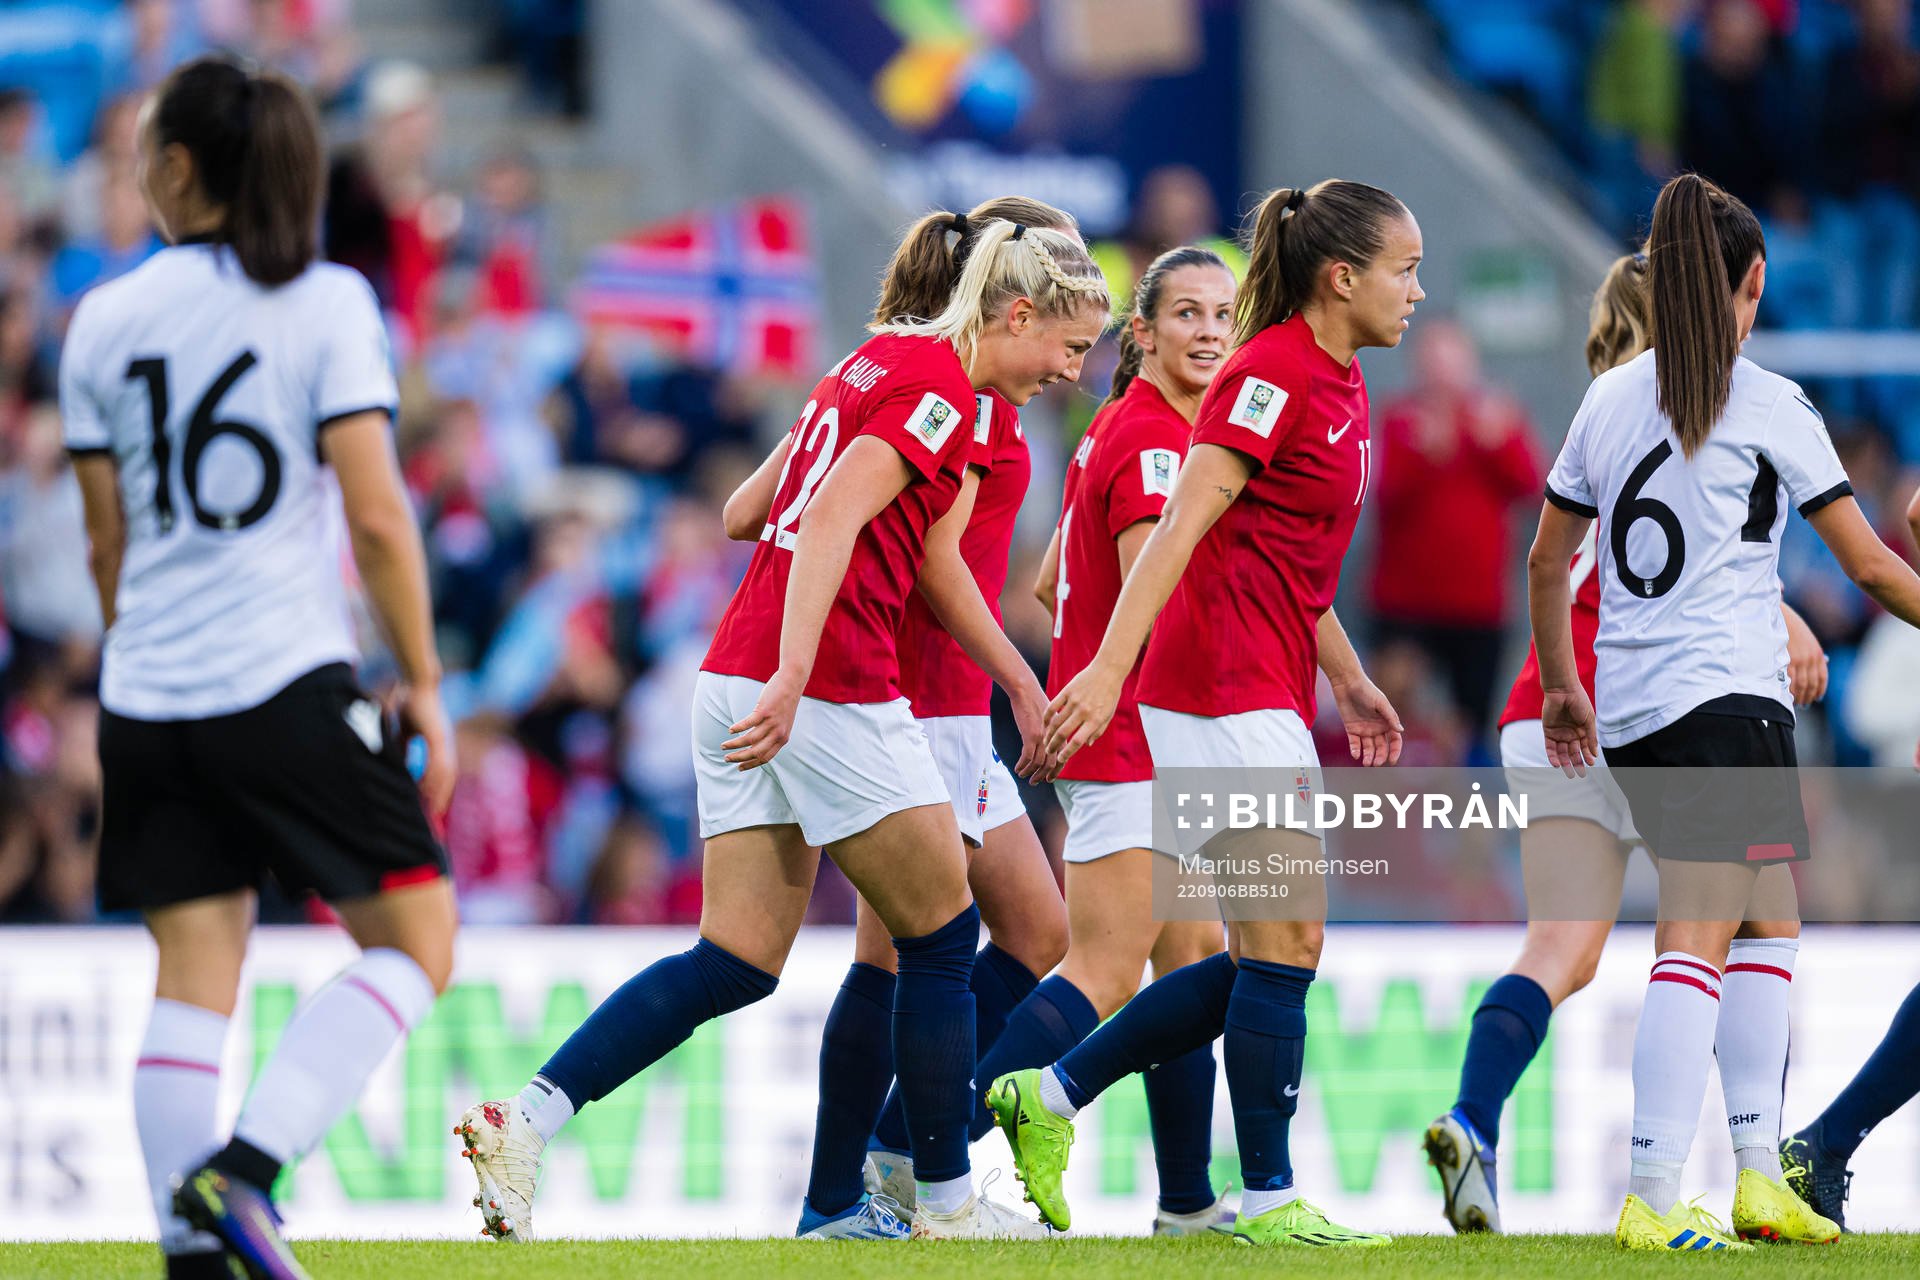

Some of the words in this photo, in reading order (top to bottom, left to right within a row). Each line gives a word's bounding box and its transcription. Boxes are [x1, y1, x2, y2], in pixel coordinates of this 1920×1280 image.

[125, 350, 281, 534] 16
[841, 355, 888, 392] HAUG
[760, 399, 839, 551] 22
[1610, 438, 1686, 599] 6
